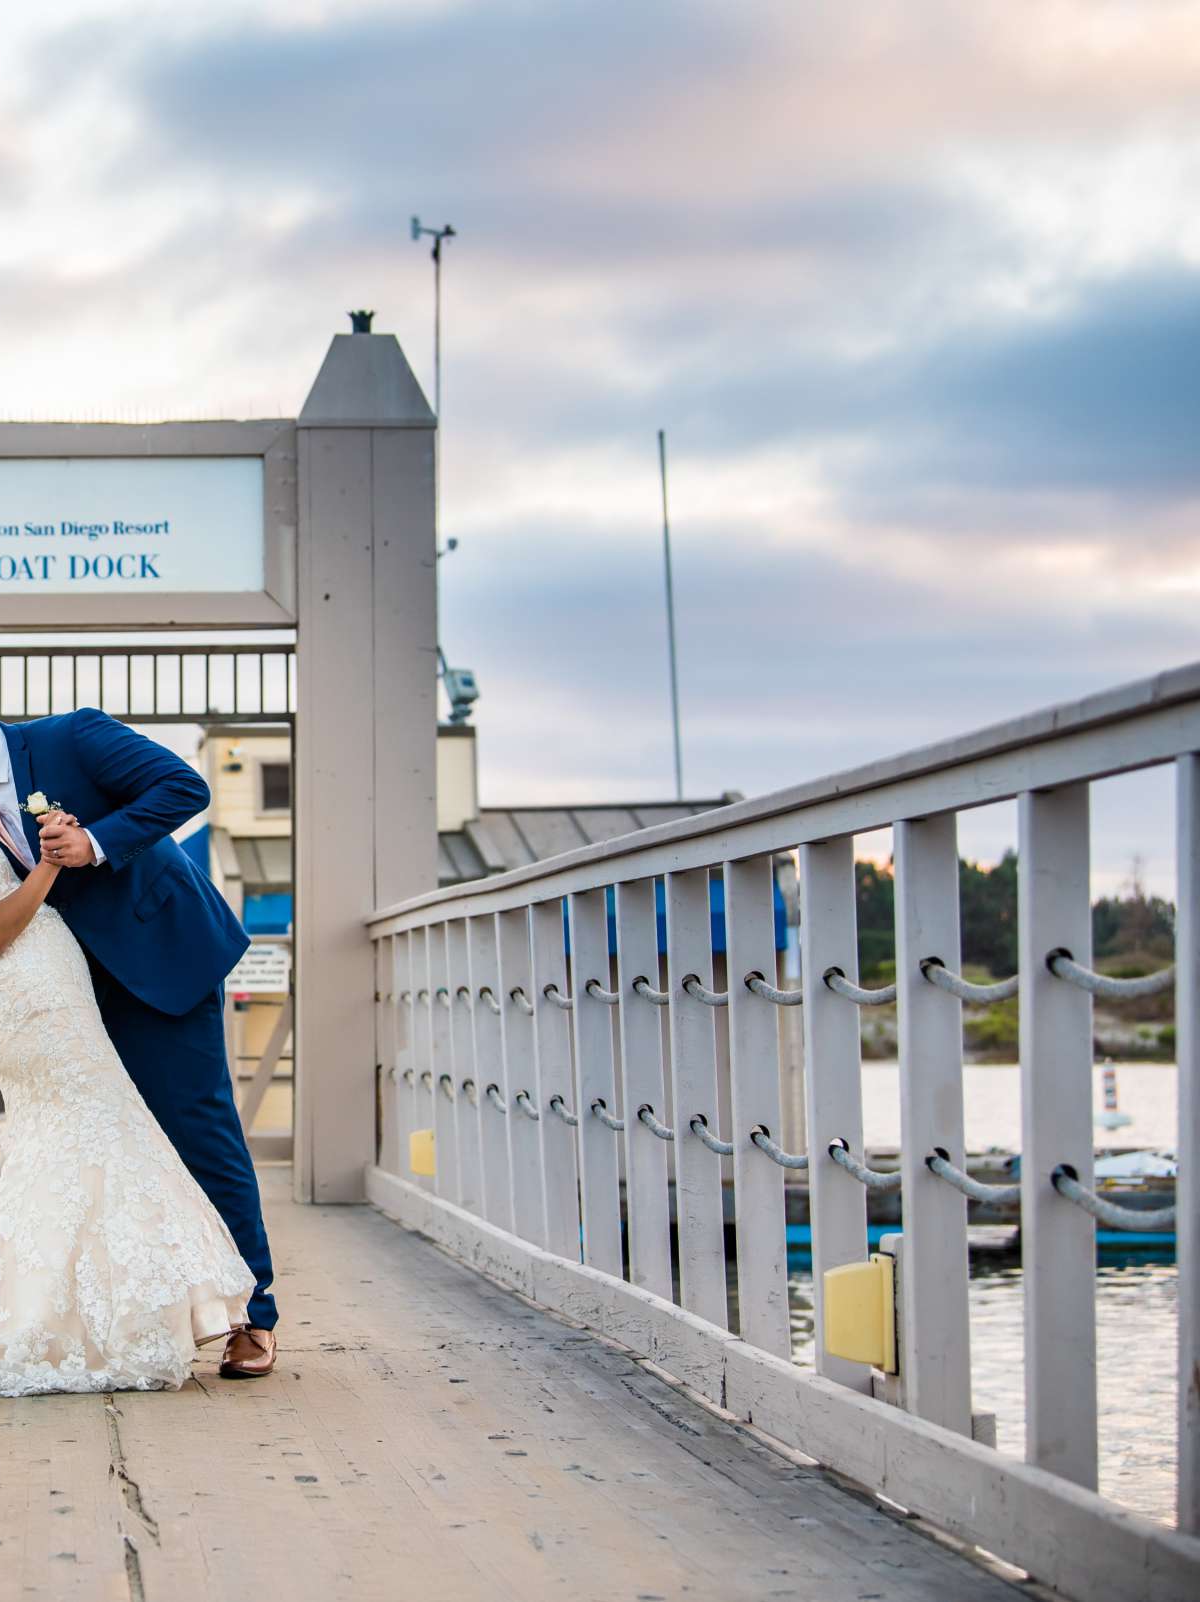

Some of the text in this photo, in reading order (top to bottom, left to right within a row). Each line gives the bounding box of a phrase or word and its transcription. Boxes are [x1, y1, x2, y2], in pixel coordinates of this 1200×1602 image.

[24, 522, 55, 536] San
[61, 521, 109, 541] Diego
[113, 520, 169, 535] Resort
[68, 554, 161, 579] DOCK
